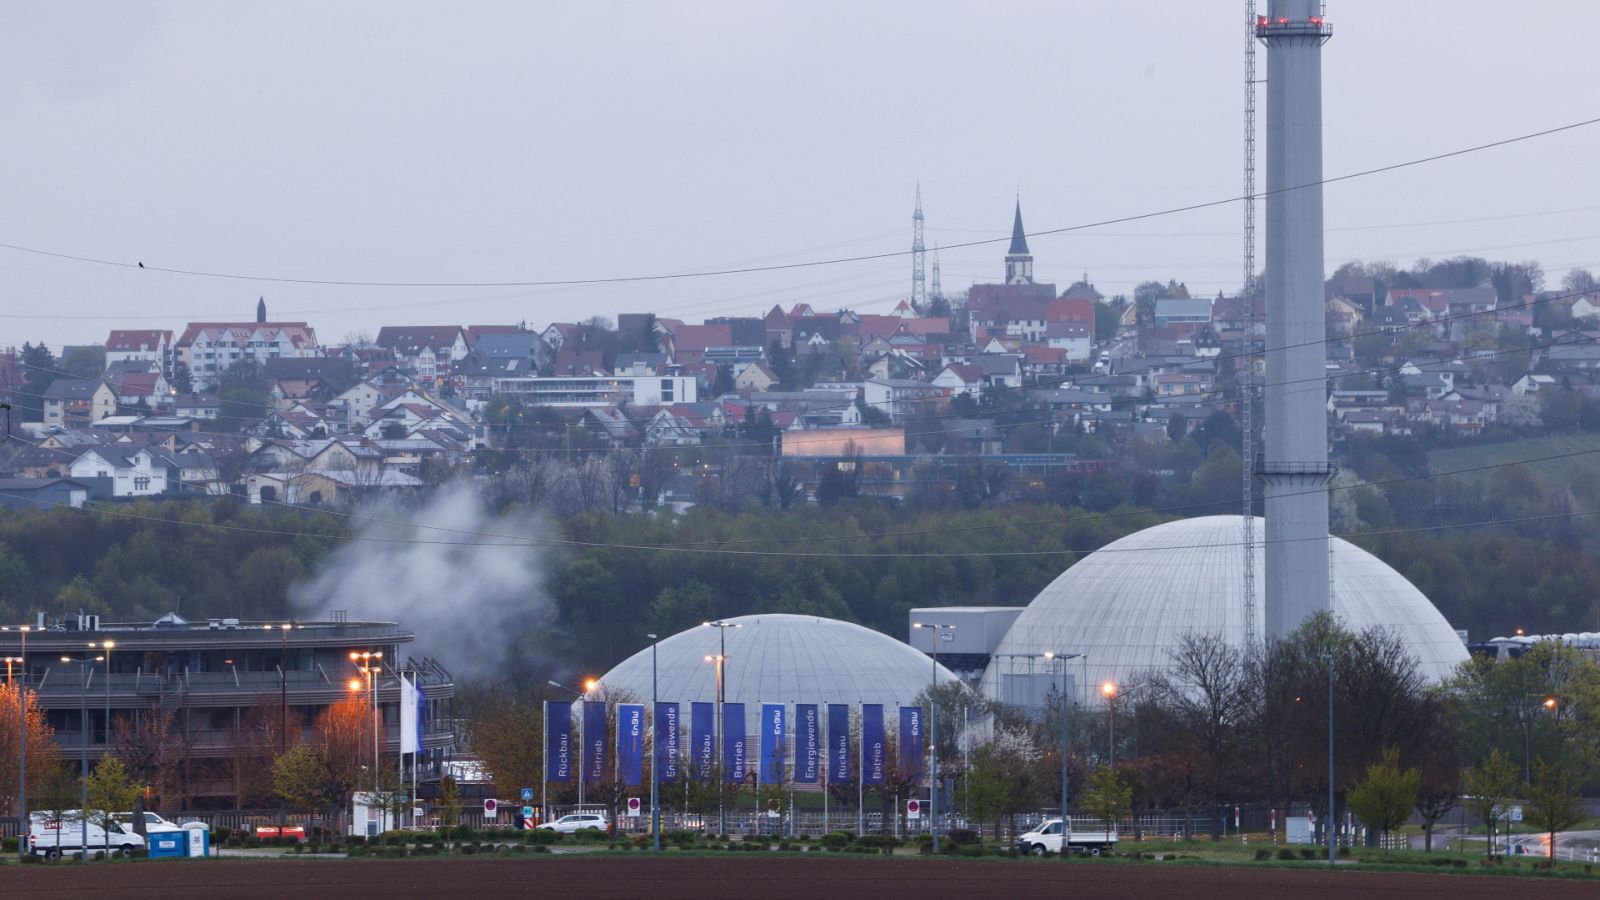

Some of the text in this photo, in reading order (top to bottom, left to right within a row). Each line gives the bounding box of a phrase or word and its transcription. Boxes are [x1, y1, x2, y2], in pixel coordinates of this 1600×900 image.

[631, 710, 639, 736] EnBW
[774, 710, 782, 735] EnBW
[911, 712, 919, 736] EnBW
[558, 733, 568, 777] Rückbau
[593, 740, 603, 777] Betrieb
[666, 707, 677, 777] Energiewende
[733, 741, 743, 778] Betrieb
[805, 709, 817, 778] Energiewende
[838, 735, 847, 778] Rückbau
[873, 742, 881, 779] Betrieb
